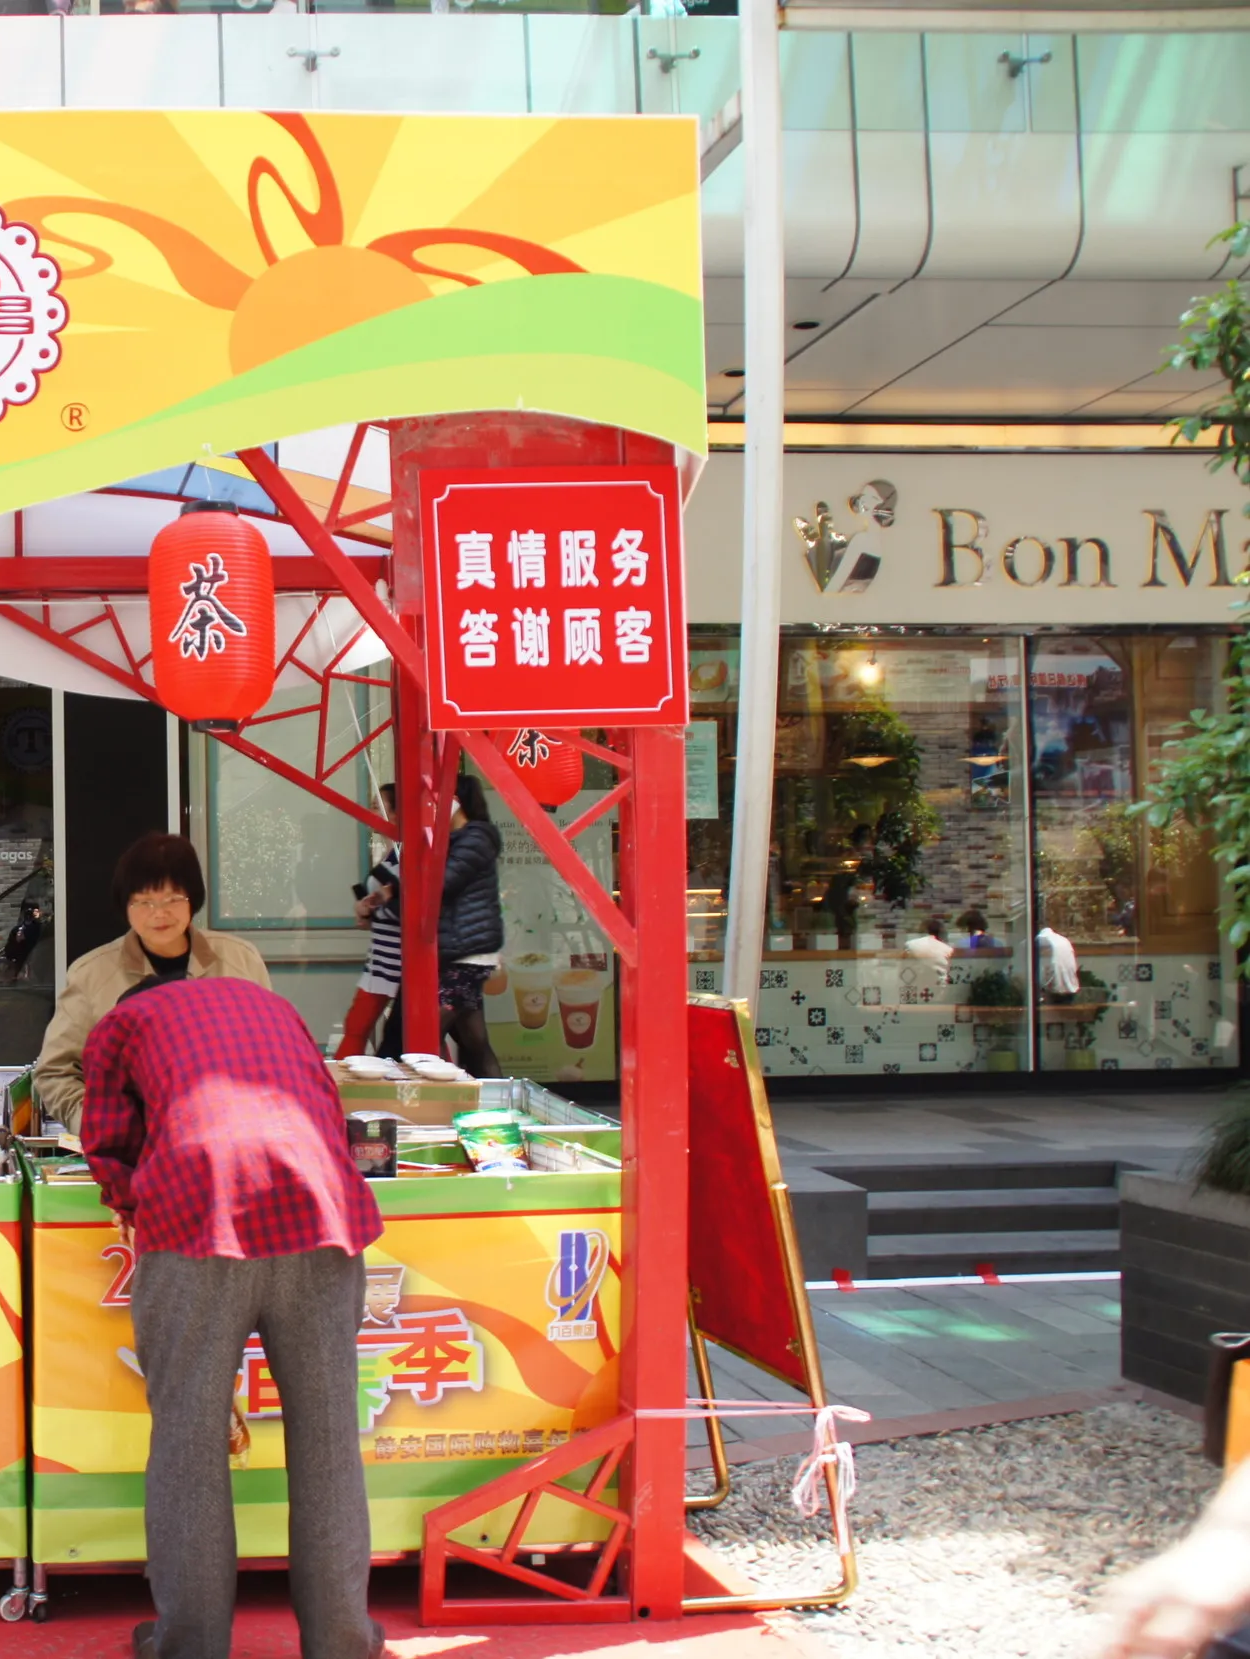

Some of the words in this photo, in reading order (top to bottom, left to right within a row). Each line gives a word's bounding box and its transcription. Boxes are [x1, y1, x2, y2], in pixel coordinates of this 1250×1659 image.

[454, 528, 649, 589] 真情服务
[932, 508, 1117, 588] Bon
[1141, 508, 1250, 588] M
[168, 552, 248, 662] 茶
[459, 606, 653, 667] 答谢顾客
